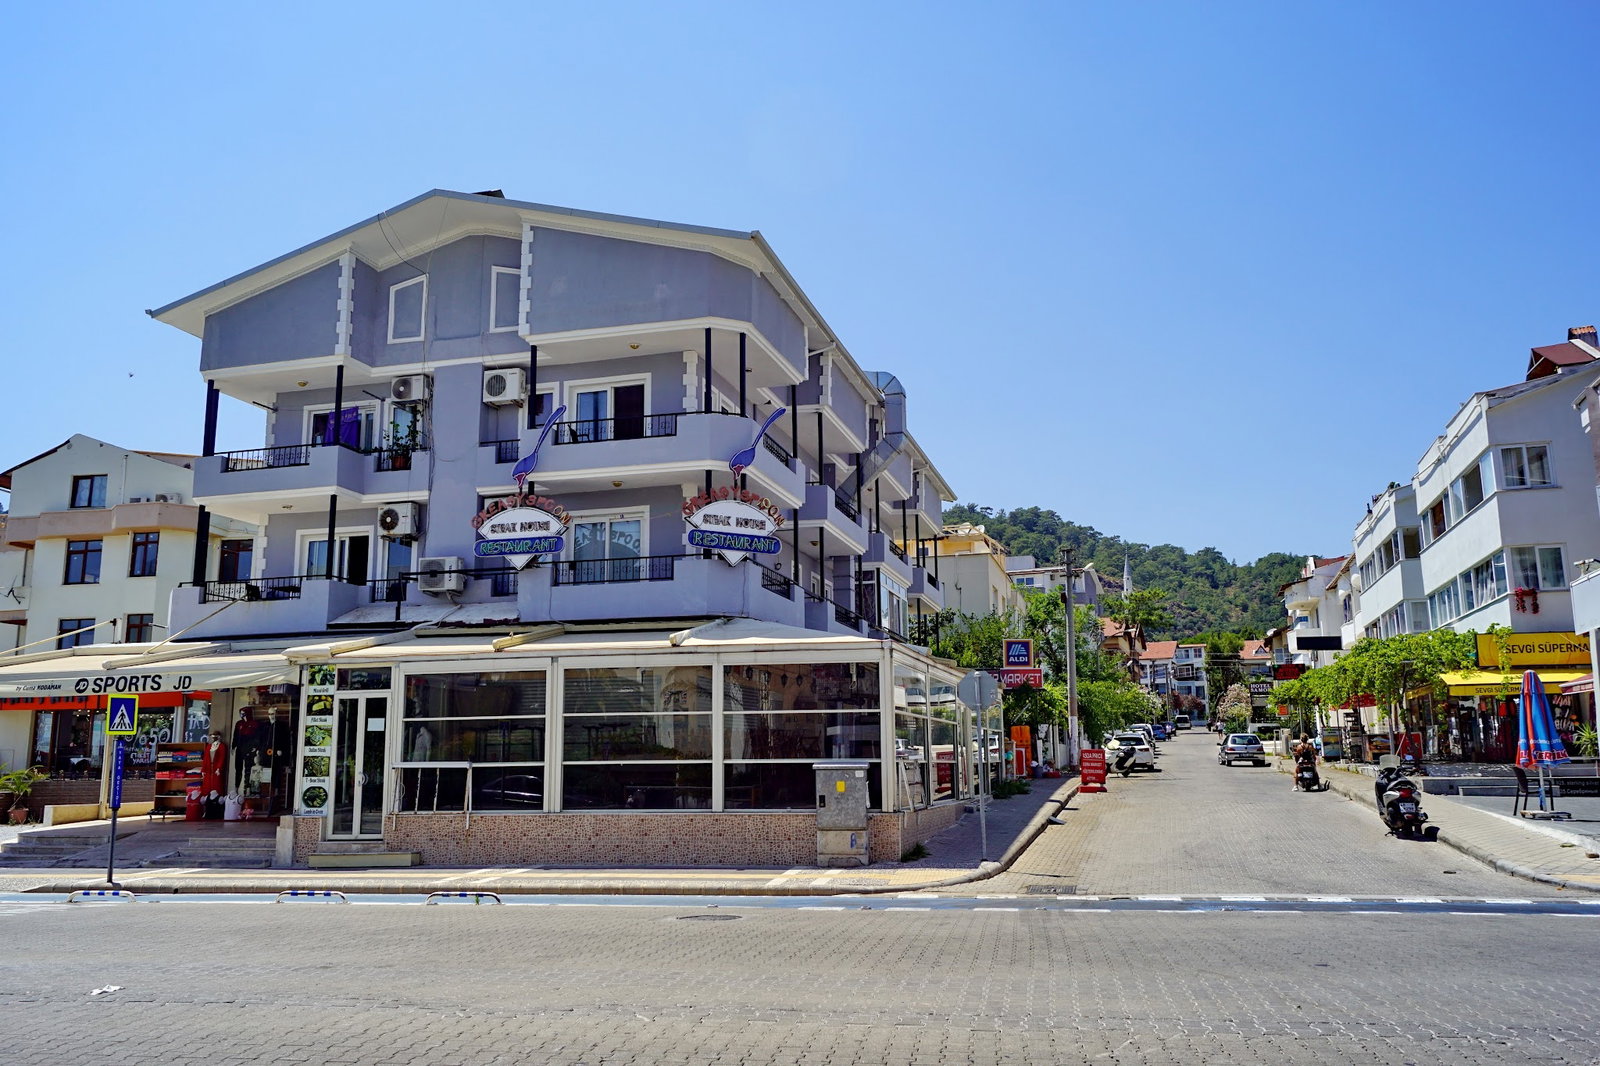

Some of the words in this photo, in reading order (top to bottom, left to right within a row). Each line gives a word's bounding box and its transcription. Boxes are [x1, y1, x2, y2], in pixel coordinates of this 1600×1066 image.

[490, 522, 517, 534] STEAK
[520, 520, 550, 532] HOUSE
[703, 514, 731, 526] STEAK
[736, 517, 766, 530] HOUSE
[480, 538, 557, 555] RESTAURANT
[693, 531, 777, 552] RESTAURANT
[1505, 642, 1535, 654] SEVGİ
[91, 674, 162, 693] SPORTS
[173, 675, 192, 690] JD
